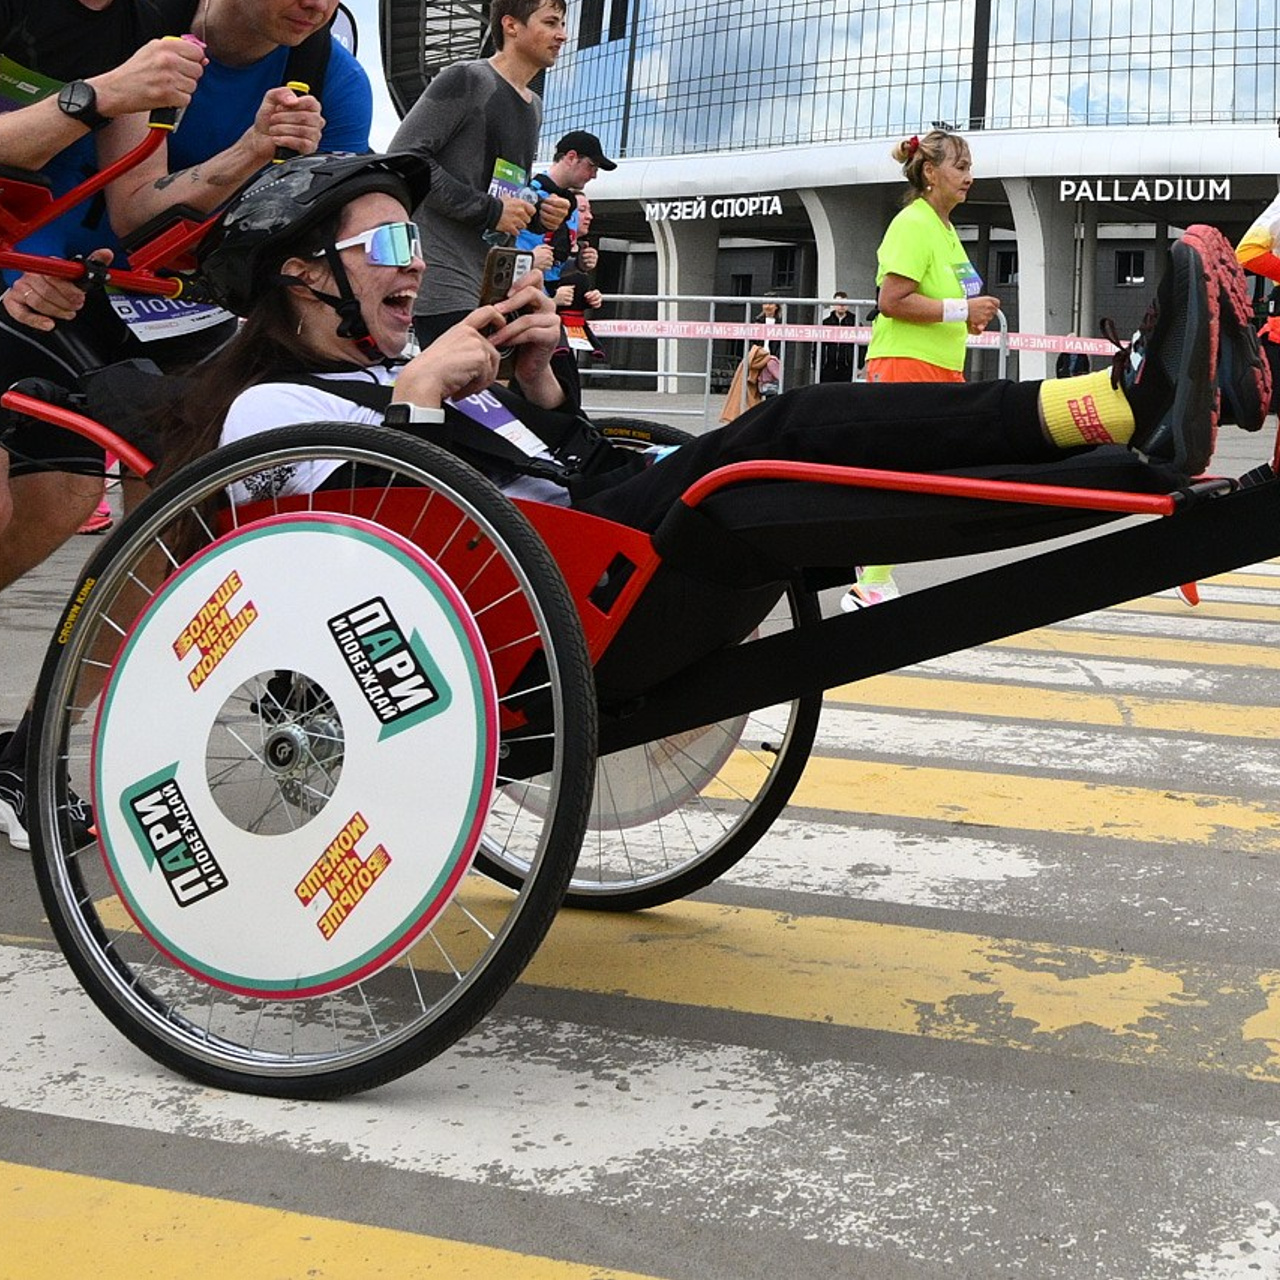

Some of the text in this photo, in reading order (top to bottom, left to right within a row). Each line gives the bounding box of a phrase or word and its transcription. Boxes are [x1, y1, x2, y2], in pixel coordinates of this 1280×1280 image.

[645, 195, 783, 221] МУЗЕЙ СПОРТА
[1059, 178, 1232, 202] PALLADIUM
[58, 577, 96, 644] CROWN KING
[175, 572, 241, 657] БОЛЬШЕ
[189, 607, 256, 689] МОЖЕШЬ
[197, 608, 230, 648] ЧЕМ
[331, 618, 399, 720] И ПОБЕЖДАЙ
[348, 601, 434, 712] ПАРИ
[134, 790, 209, 902] ПАРИ
[162, 783, 224, 888] И ПОБЕЖДАЙ
[297, 814, 367, 899] МОЖЕШЬ
[325, 856, 362, 899] ЧЕМ
[318, 846, 389, 938] БОЛЬШЕ
